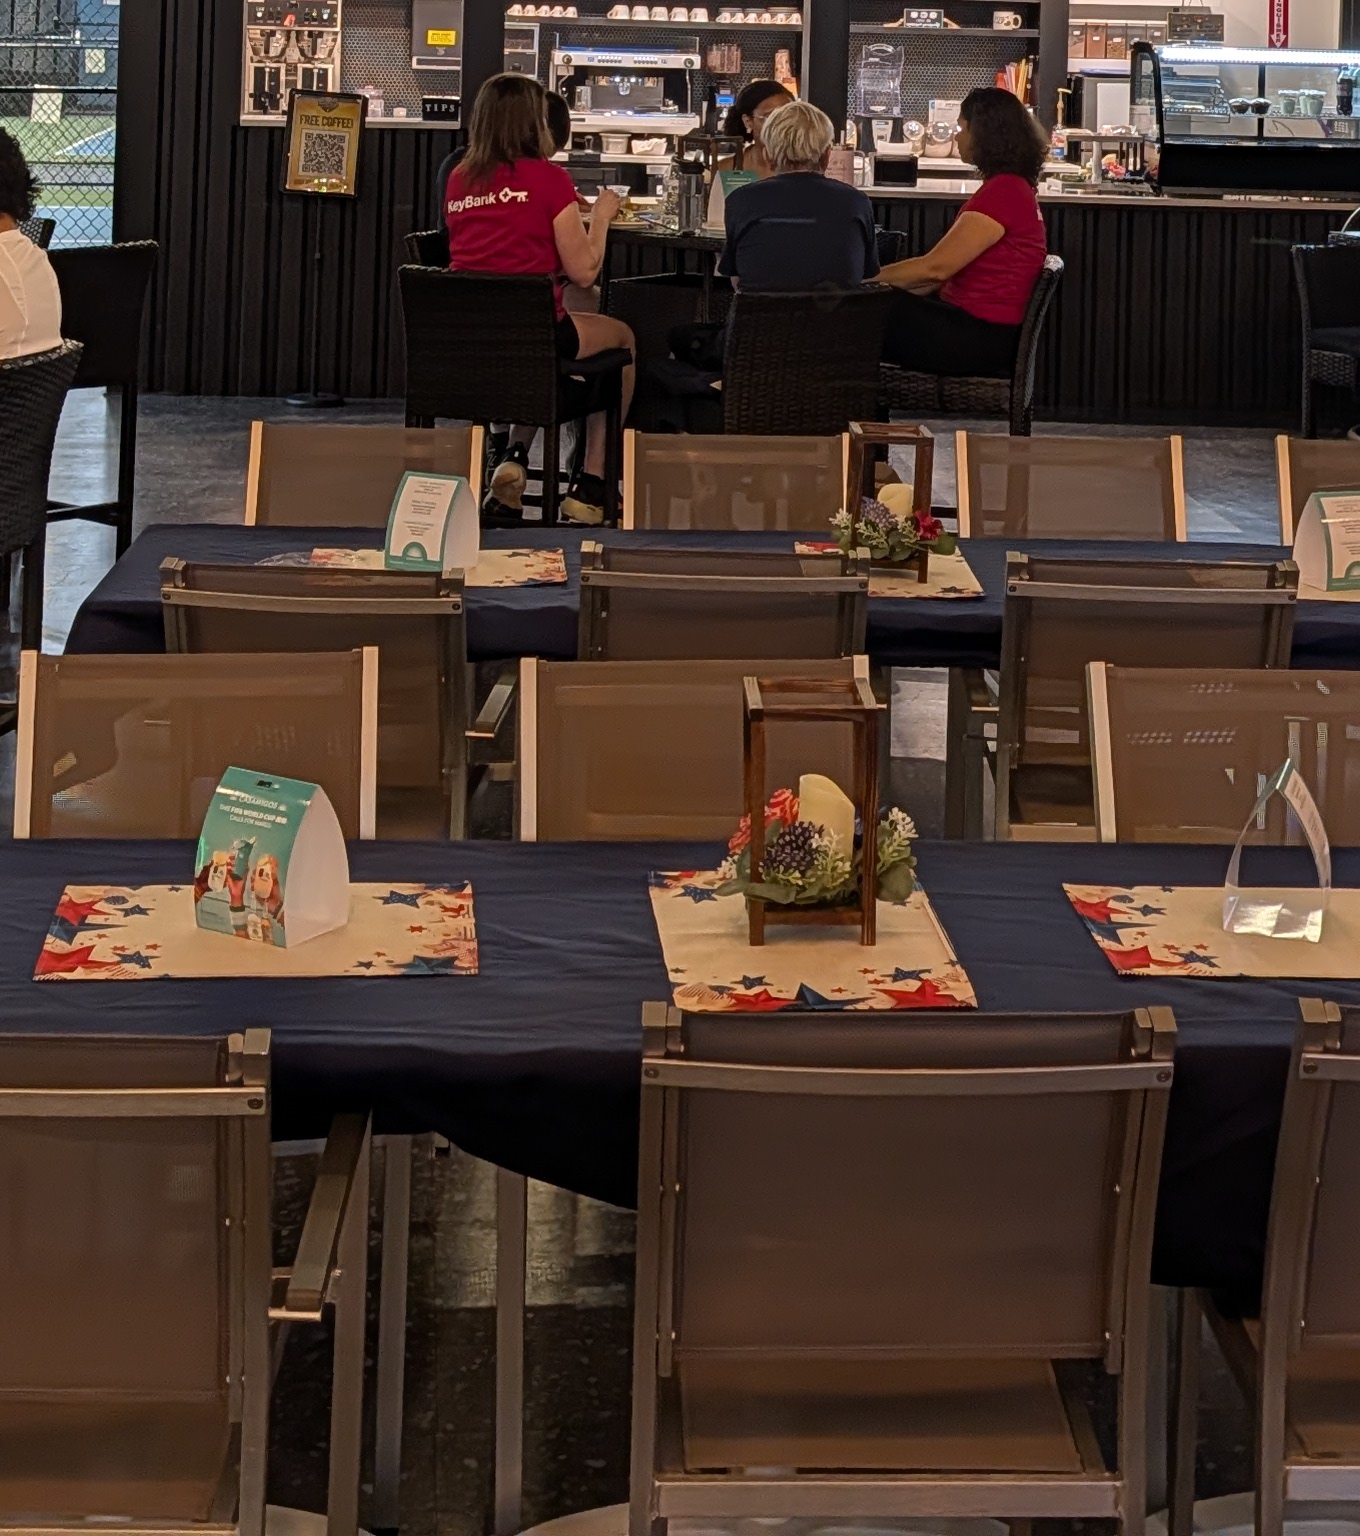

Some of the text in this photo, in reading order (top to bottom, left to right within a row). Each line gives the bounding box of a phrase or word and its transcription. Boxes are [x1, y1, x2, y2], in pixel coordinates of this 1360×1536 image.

[425, 104, 455, 113] TIPS
[299, 114, 320, 127] FREE
[447, 192, 497, 214] KeyBank
